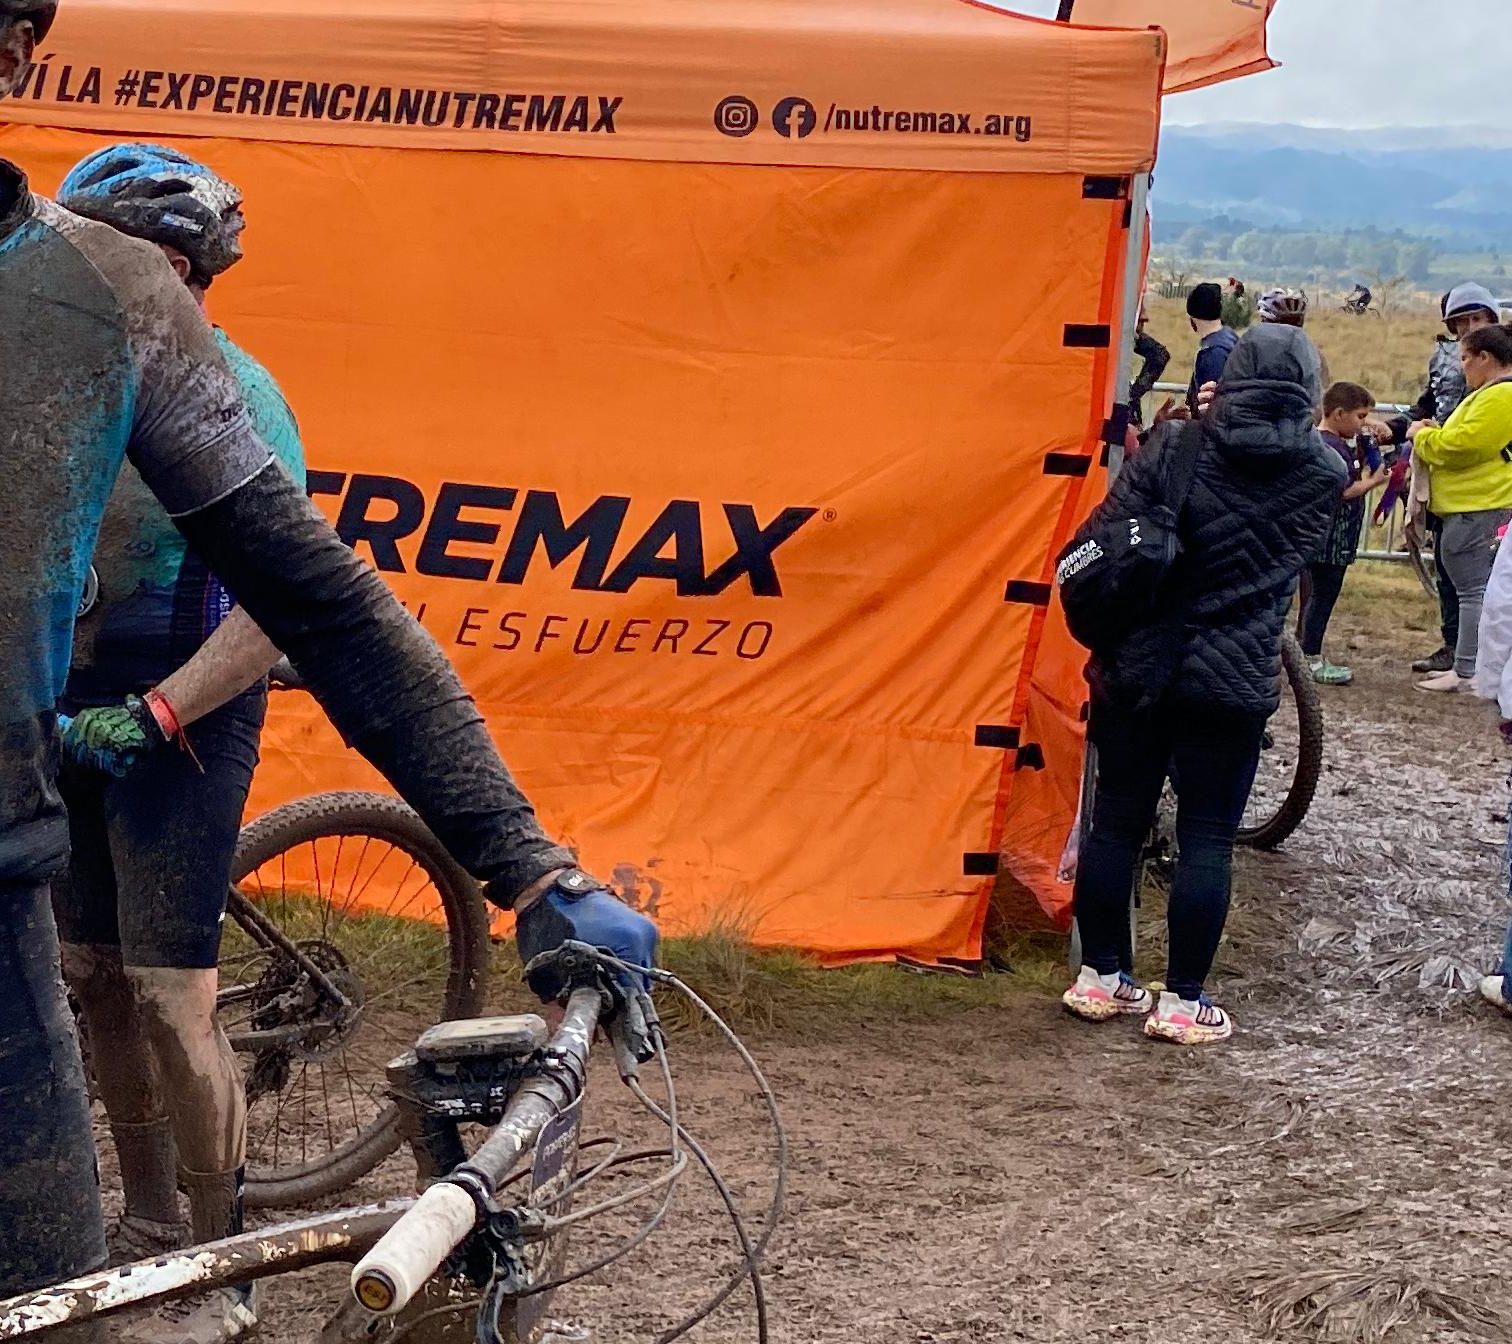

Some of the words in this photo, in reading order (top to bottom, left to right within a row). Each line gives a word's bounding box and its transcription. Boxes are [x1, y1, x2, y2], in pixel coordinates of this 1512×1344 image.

[56, 66, 101, 104] LA
[115, 68, 623, 133] #EXPERIENCIANUTREMAX
[824, 103, 1032, 142] /nutremax.arg
[306, 469, 819, 598] REMAX
[455, 608, 773, 659] ESFUERZO
